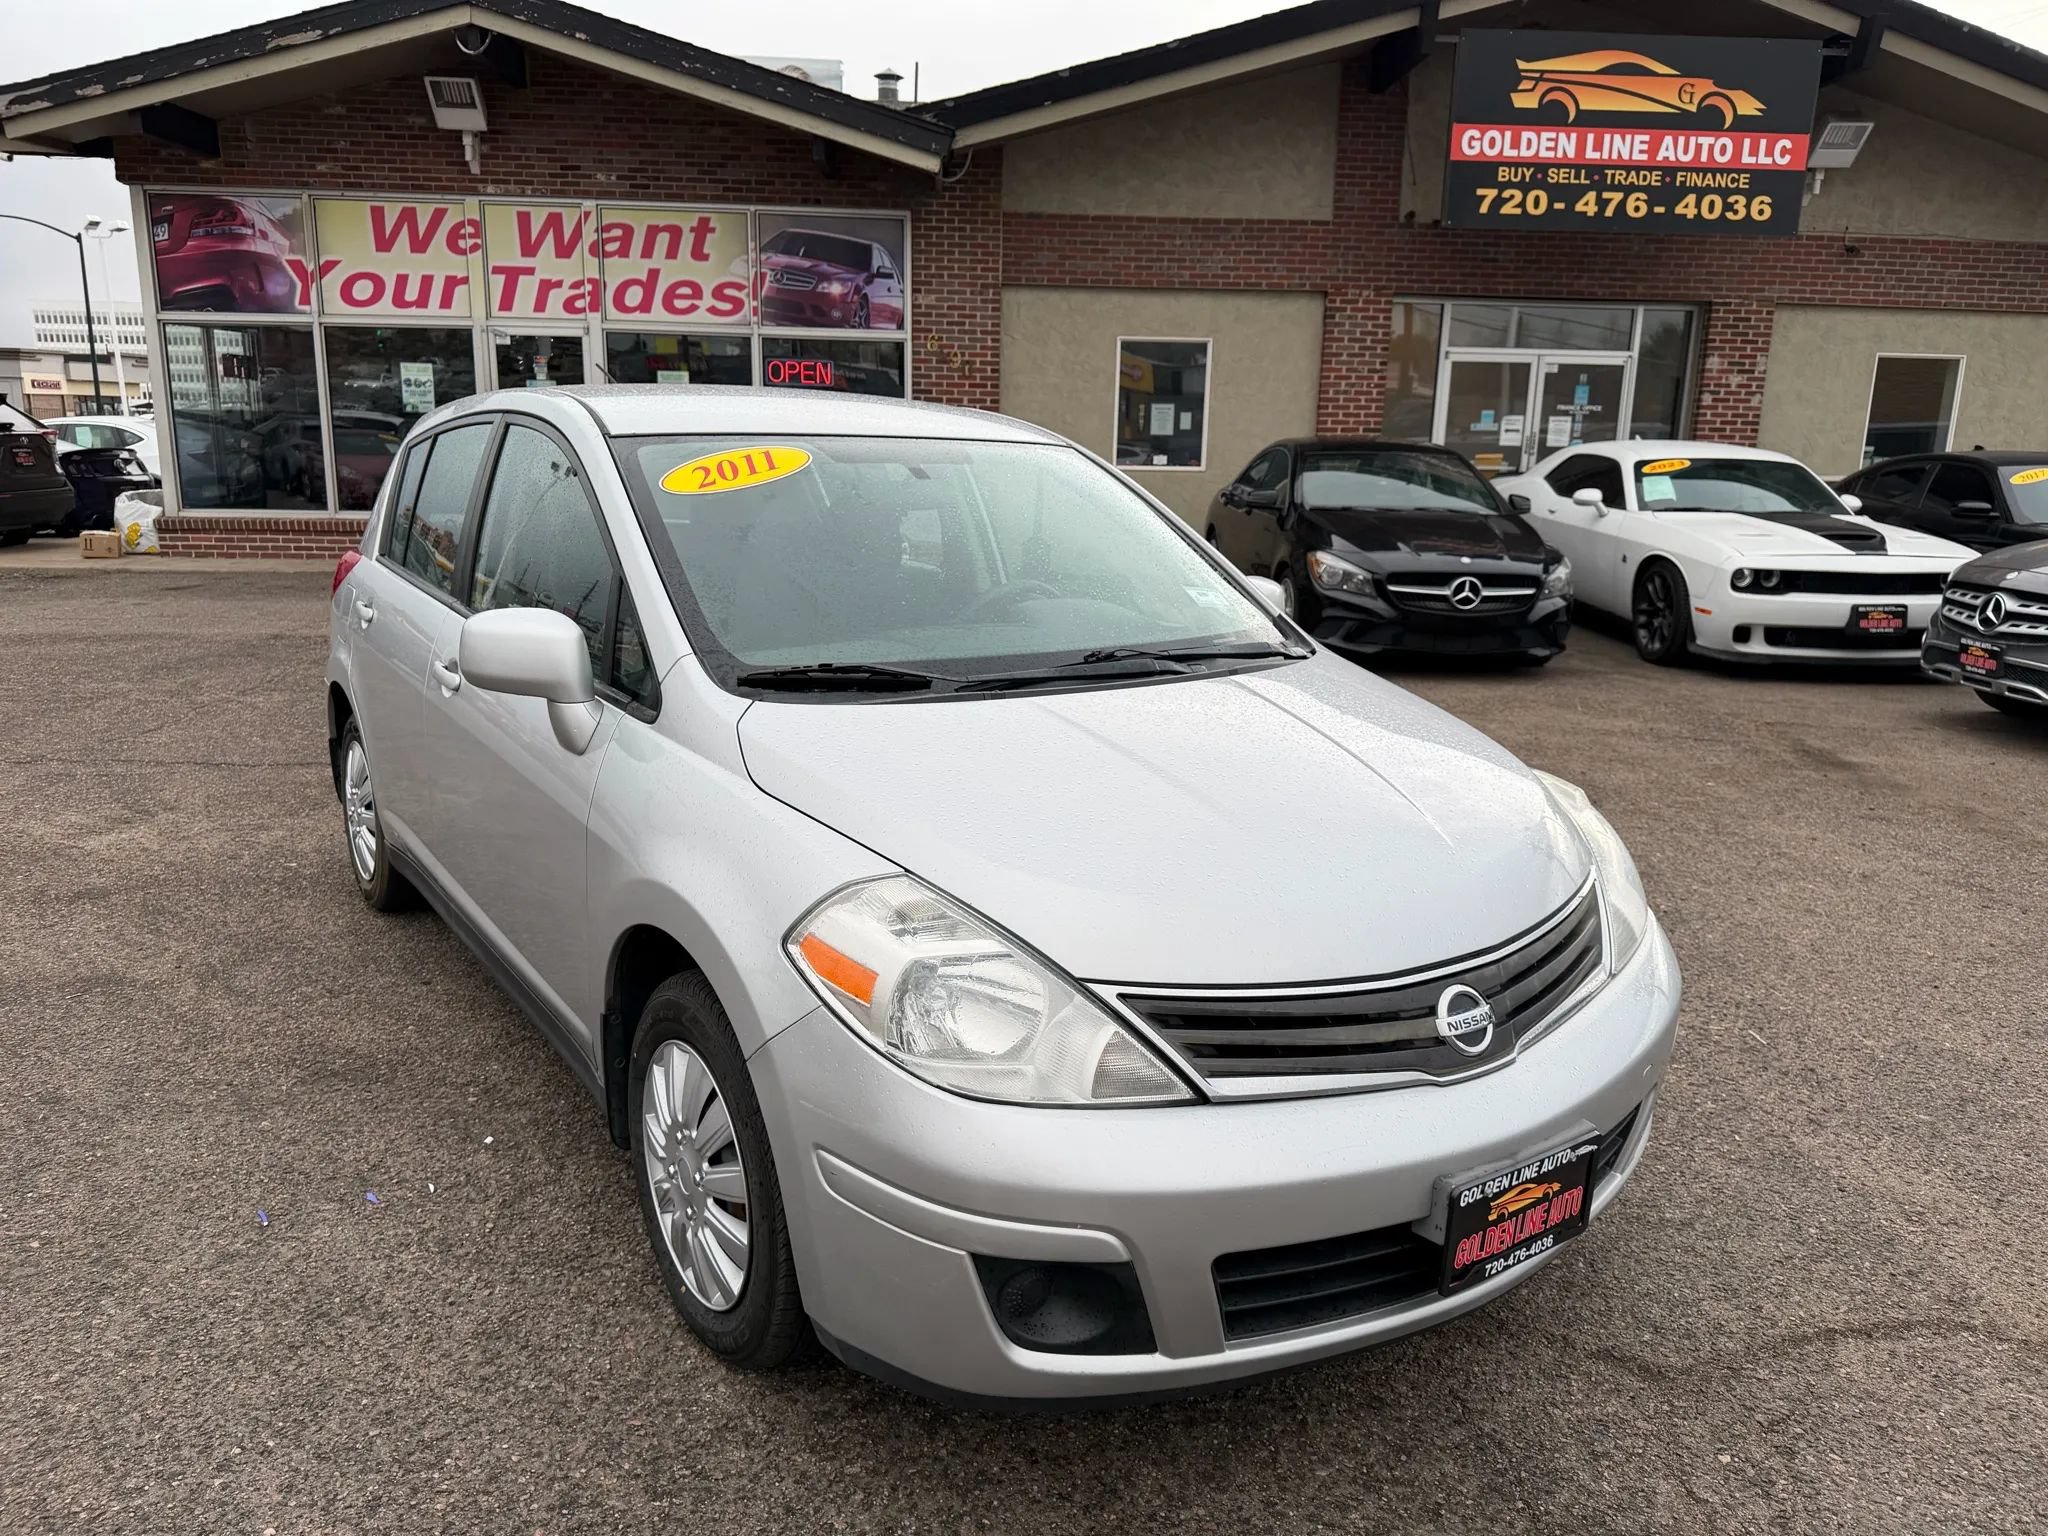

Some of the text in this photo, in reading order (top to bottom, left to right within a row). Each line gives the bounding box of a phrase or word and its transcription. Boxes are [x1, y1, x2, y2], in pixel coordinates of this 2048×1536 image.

[1461, 128, 1793, 165] GOLDEN LINE AUTO LLC
[1497, 166, 1750, 188] BUY SELL TRADE FINANCE
[369, 204, 717, 262] We Want
[285, 258, 768, 317] Your Trades!
[768, 360, 831, 384] OPEN
[691, 450, 778, 489] 2011
[1446, 1011, 1494, 1033] NISSAN
[1459, 1148, 1572, 1207] GOLDEN LINE AUTO
[1454, 1185, 1584, 1269] GOLDEN LINE AUTO
[1485, 1234, 1554, 1277] 720-476-4036
